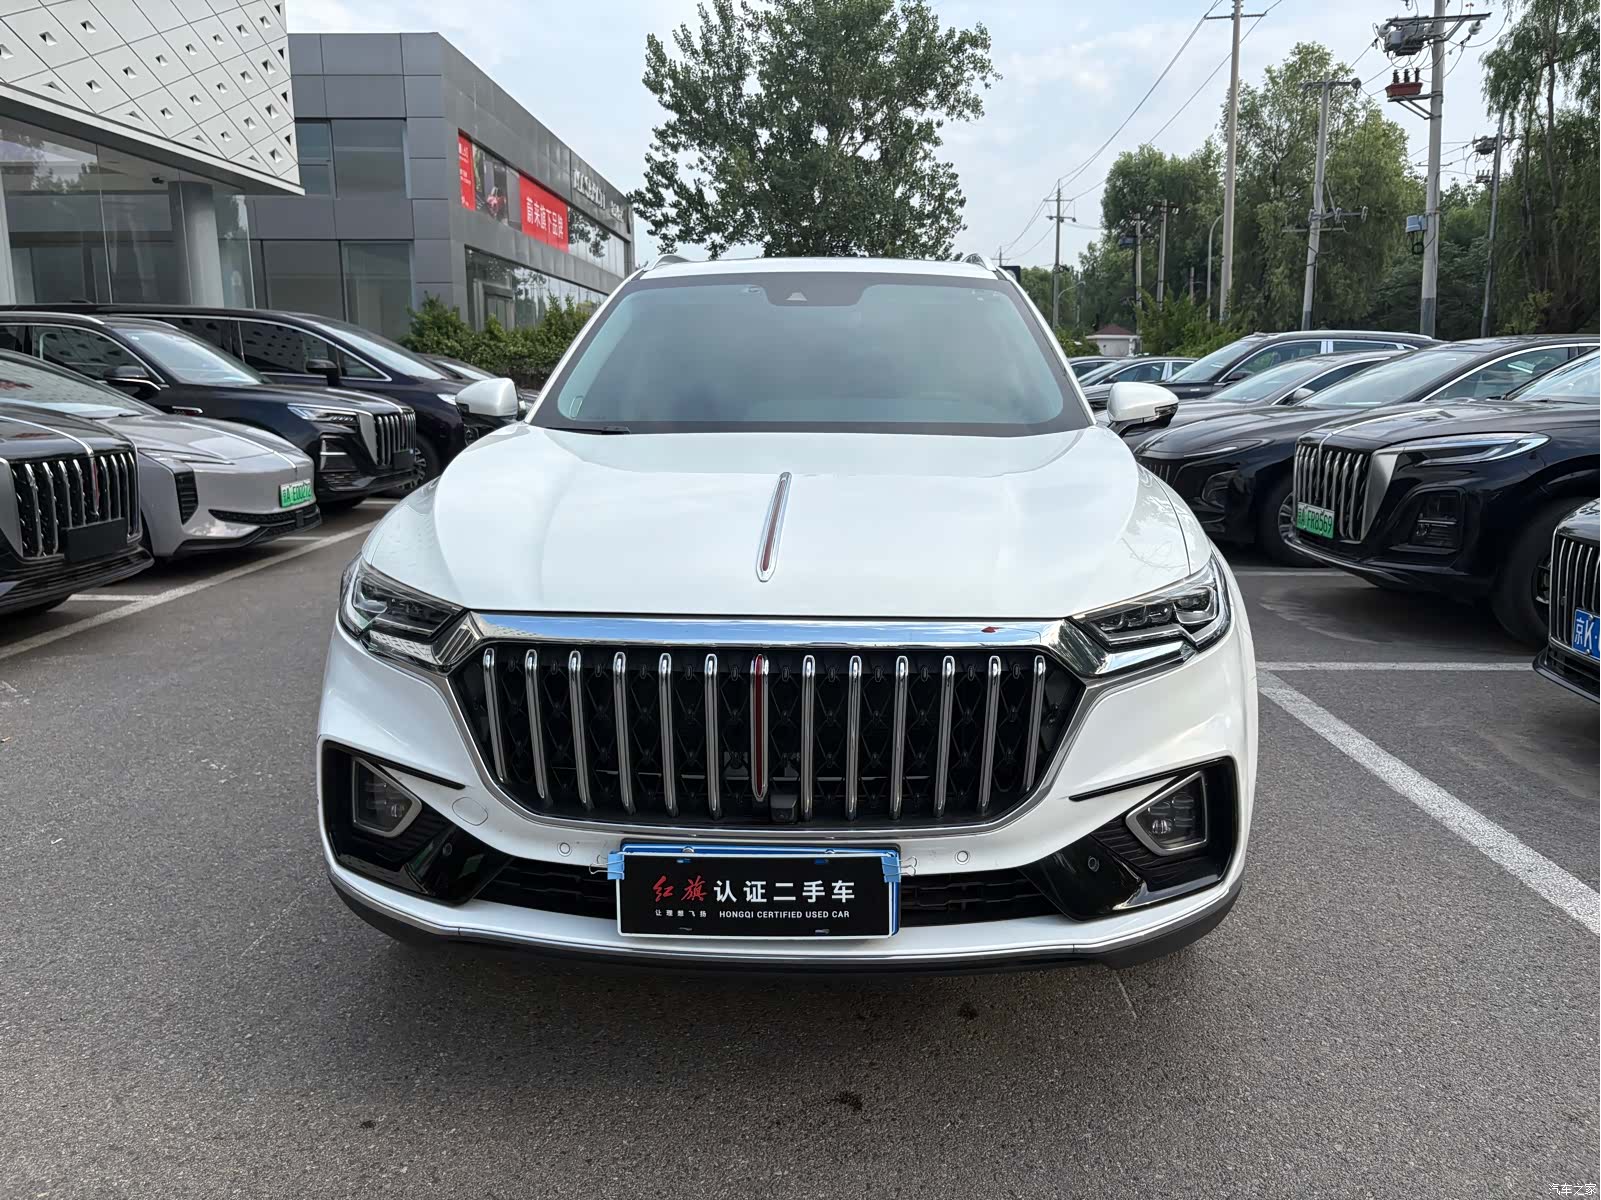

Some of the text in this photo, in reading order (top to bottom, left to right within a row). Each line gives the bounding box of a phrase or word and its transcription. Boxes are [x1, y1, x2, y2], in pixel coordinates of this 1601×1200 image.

[526, 196, 564, 240] 蔚来旗下品牌
[655, 909, 707, 918] 让理想飞扬
[719, 910, 850, 919] HONGQI CERTIFIED USED CAR
